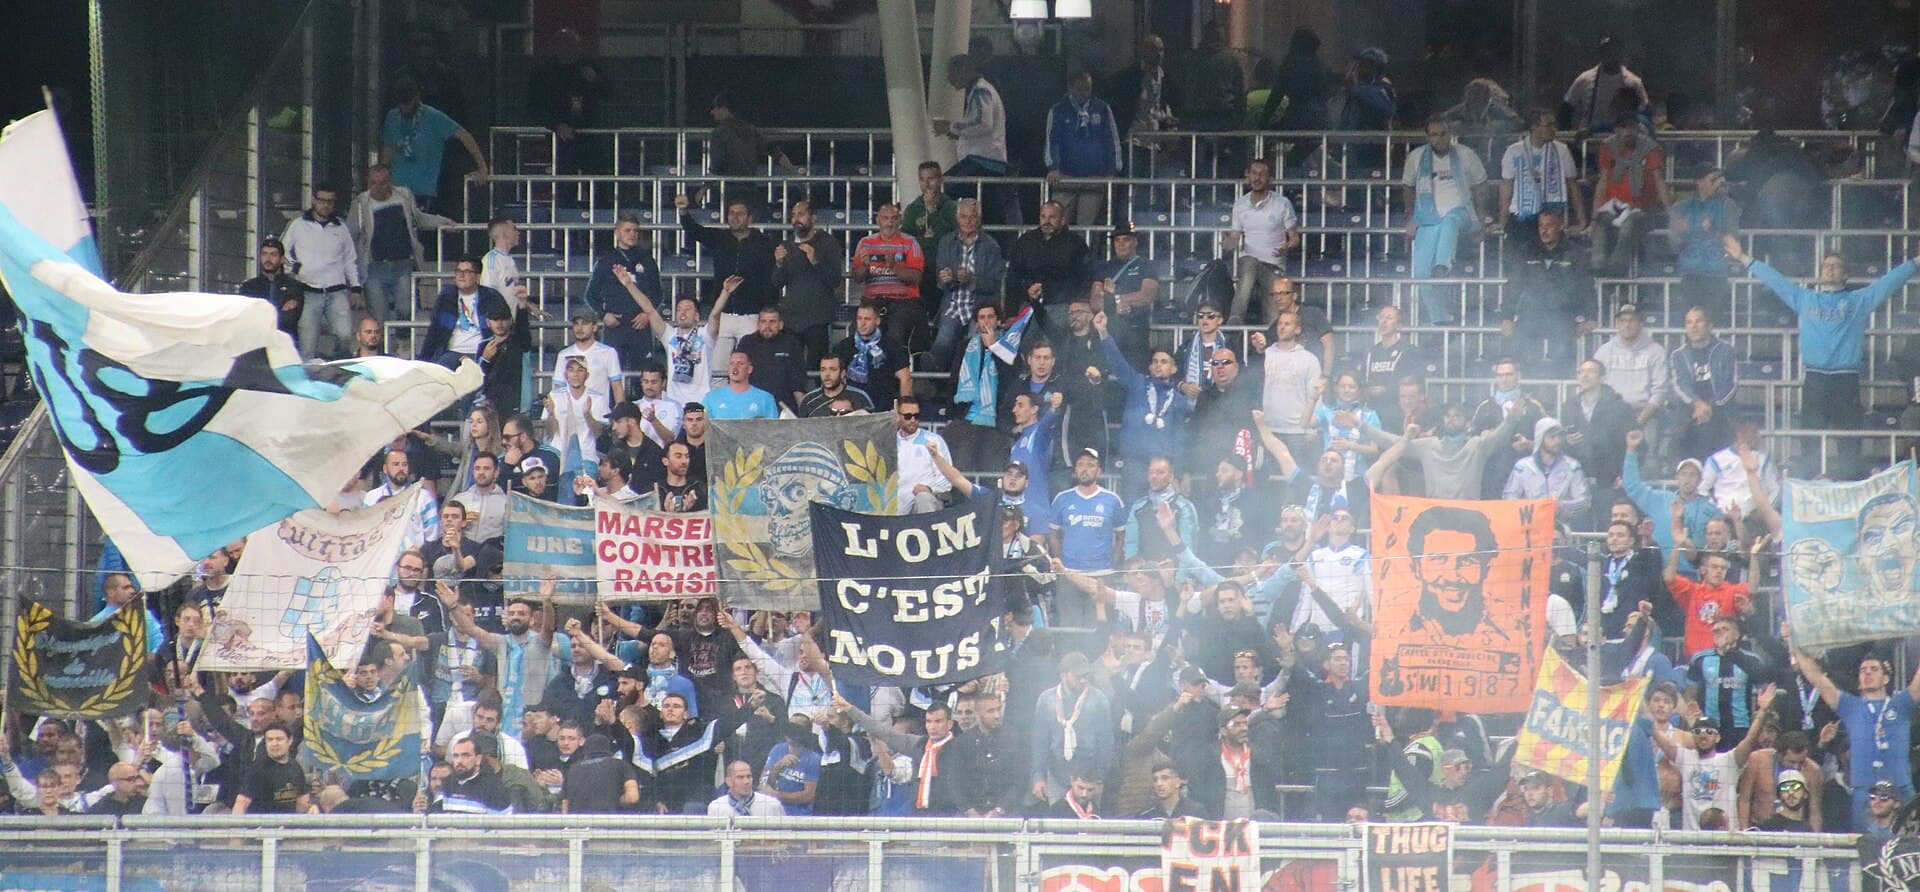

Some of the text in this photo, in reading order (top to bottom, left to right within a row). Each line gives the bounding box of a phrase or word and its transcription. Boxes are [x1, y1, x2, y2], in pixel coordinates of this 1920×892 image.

[841, 512, 982, 563] L'OM
[837, 565, 990, 623] C'EST
[1161, 819, 1251, 858] FCK
[1372, 825, 1448, 855] THUG
[1381, 866, 1440, 892] LIFE
